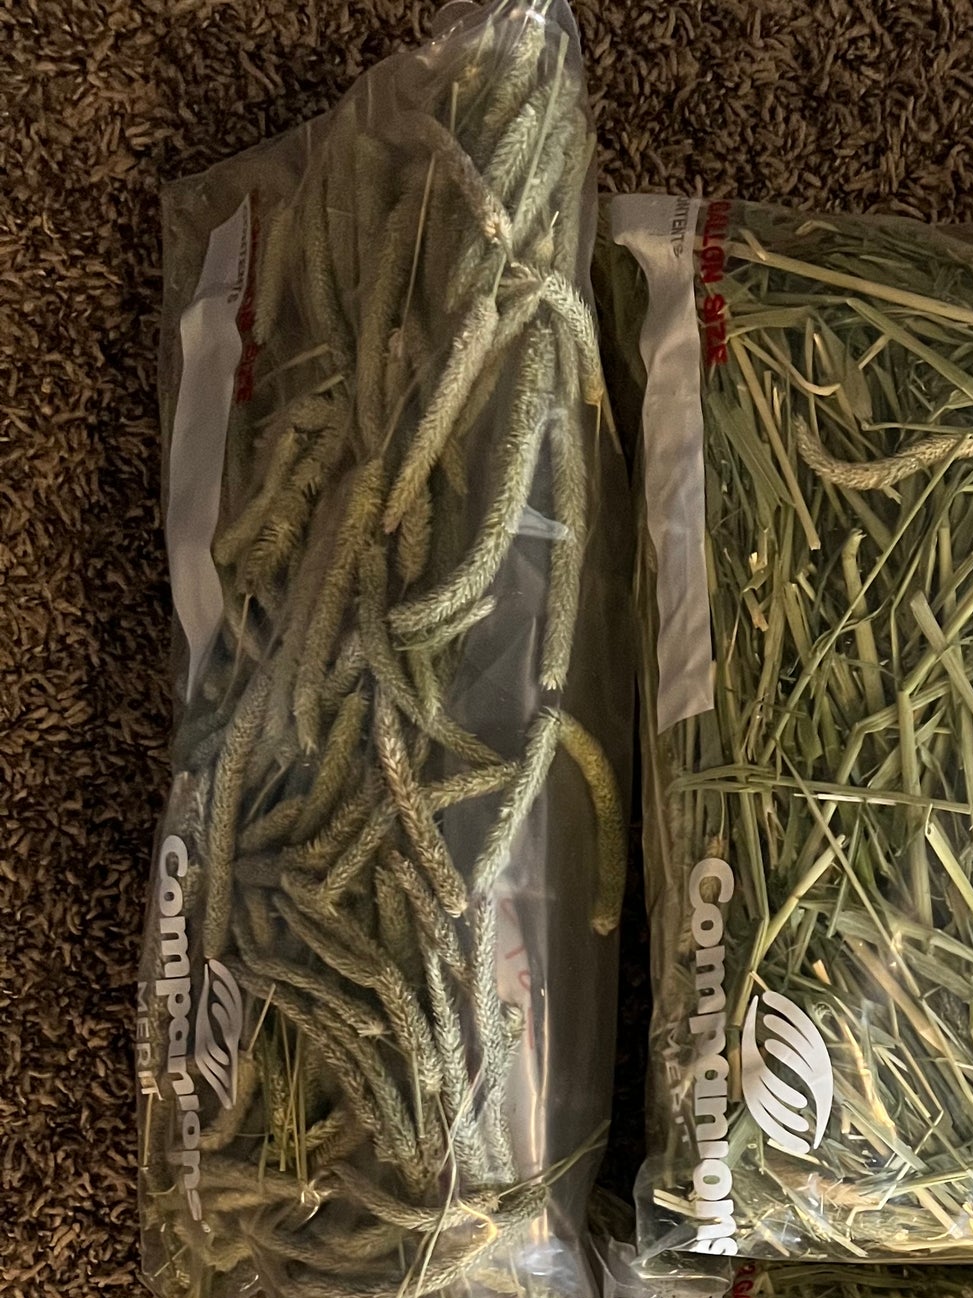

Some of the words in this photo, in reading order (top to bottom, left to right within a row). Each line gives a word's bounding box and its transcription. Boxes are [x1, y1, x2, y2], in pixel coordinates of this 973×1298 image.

[671, 197, 690, 258] ONTENTS
[704, 294, 728, 366] SIZE
[137, 981, 162, 1102] MERIT
[156, 834, 203, 1221] Companions
[663, 1021, 691, 1145] MERIT
[688, 858, 738, 1255] Companions
